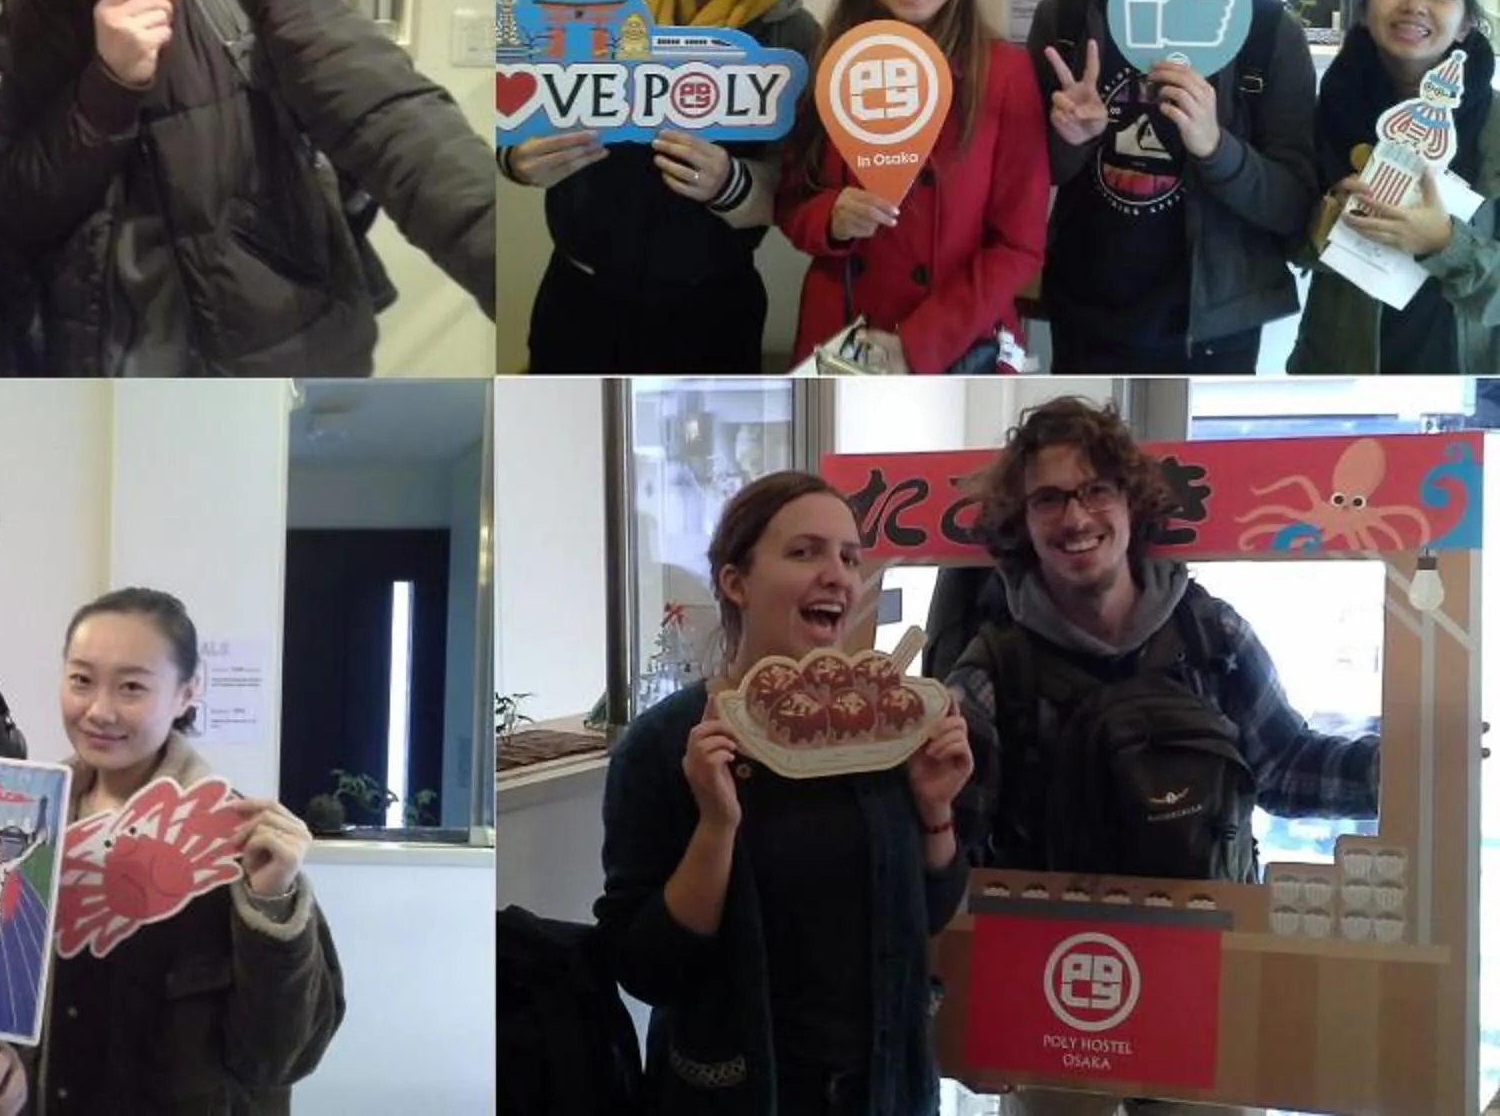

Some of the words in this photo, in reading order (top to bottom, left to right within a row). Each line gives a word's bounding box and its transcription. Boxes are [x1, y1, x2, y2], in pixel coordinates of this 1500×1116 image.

[873, 152, 919, 166] Osaka
[1043, 1034, 1077, 1050] POLY
[1081, 1038, 1133, 1055] HOSTEL
[1063, 1052, 1111, 1070] OSAKA
